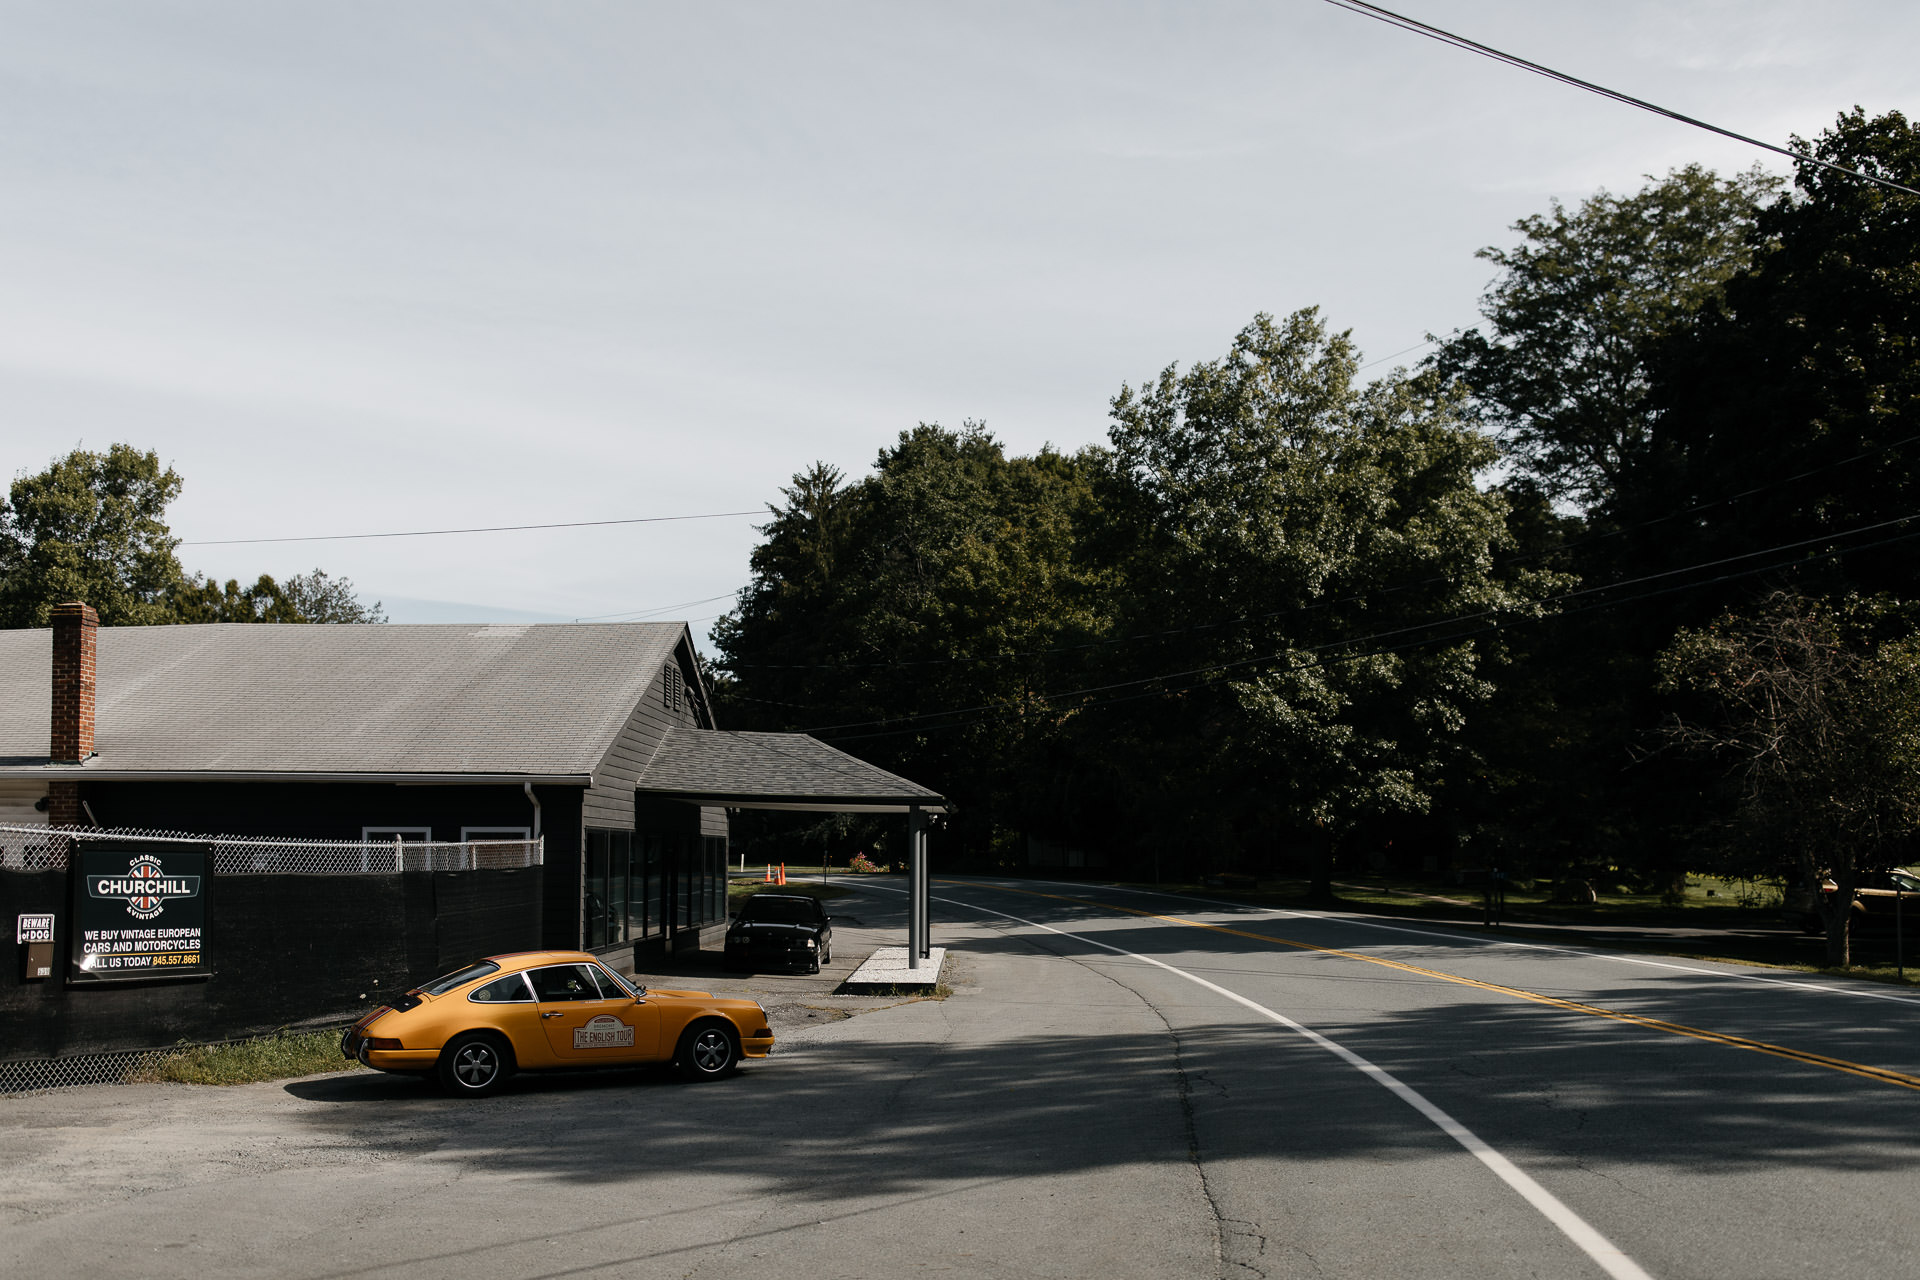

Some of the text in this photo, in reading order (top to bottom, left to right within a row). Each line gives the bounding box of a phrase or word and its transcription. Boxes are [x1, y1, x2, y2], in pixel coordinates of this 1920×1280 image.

[129, 854, 162, 867] CLASSIC
[97, 880, 190, 894] CHURCHILL
[22, 918, 50, 928] BEWARE
[21, 930, 50, 940] of DOG
[84, 928, 201, 940] WE BUY VINTAGE EUROPEAN
[83, 939, 201, 953] CARS AND MOTORCYCLES
[84, 954, 200, 968] ALL US TODAY 845.557.8661
[576, 1029, 632, 1043] THE ENGLISH TOUR
